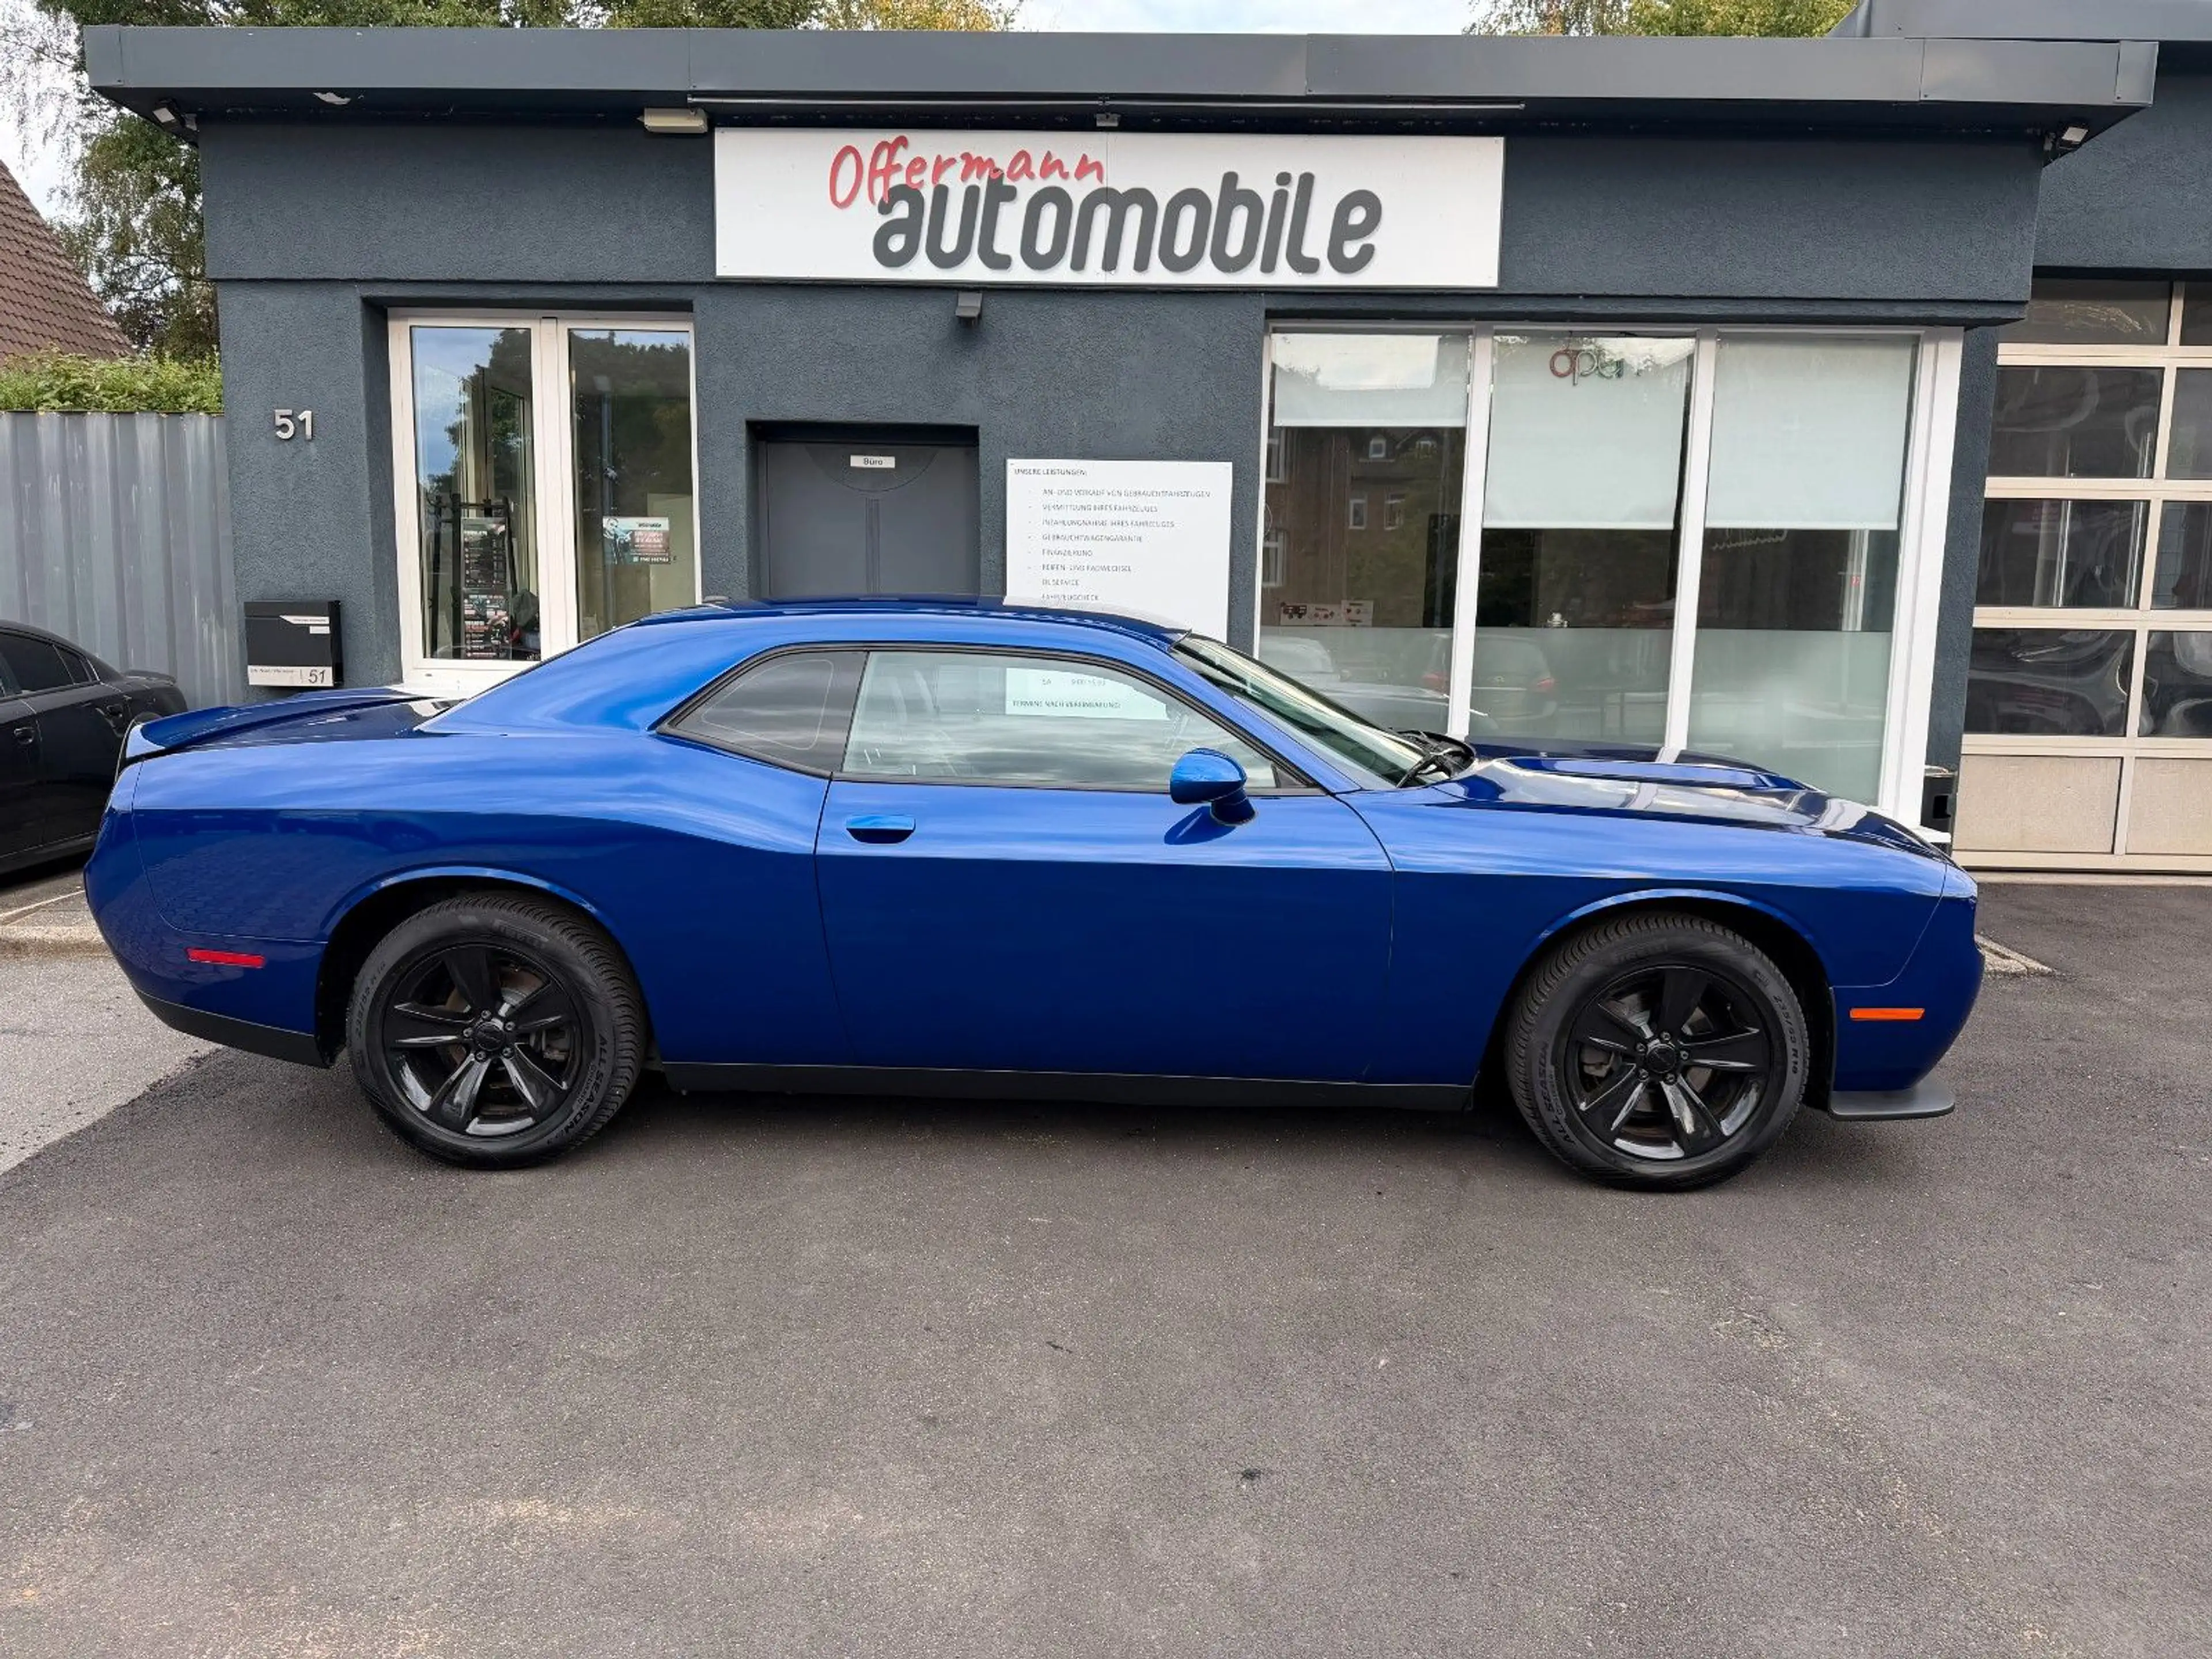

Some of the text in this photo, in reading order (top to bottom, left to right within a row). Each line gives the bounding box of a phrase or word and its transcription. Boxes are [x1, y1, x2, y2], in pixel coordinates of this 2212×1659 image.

[828, 135, 1104, 210] Offermann
[872, 171, 1382, 275] automobile
[274, 409, 314, 441] 51
[308, 669, 325, 684] 51
